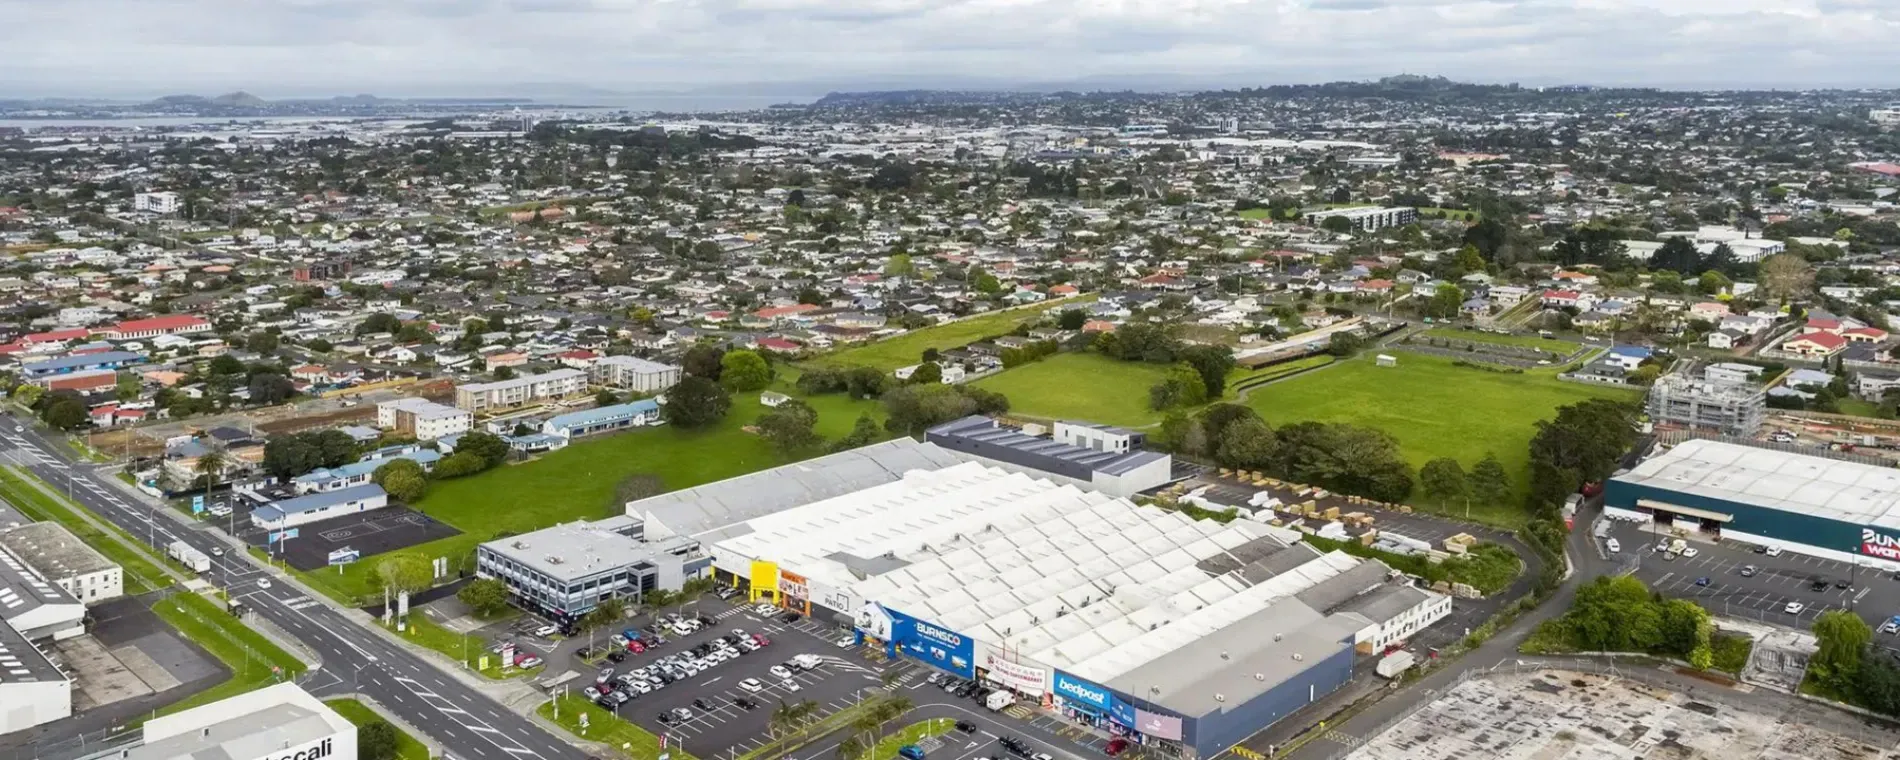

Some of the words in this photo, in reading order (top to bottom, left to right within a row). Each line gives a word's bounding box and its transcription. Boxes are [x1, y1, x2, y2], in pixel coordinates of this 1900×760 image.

[825, 597, 844, 610] PATIO
[916, 622, 960, 646] BURNSCO
[1059, 678, 1105, 704] bedpost
